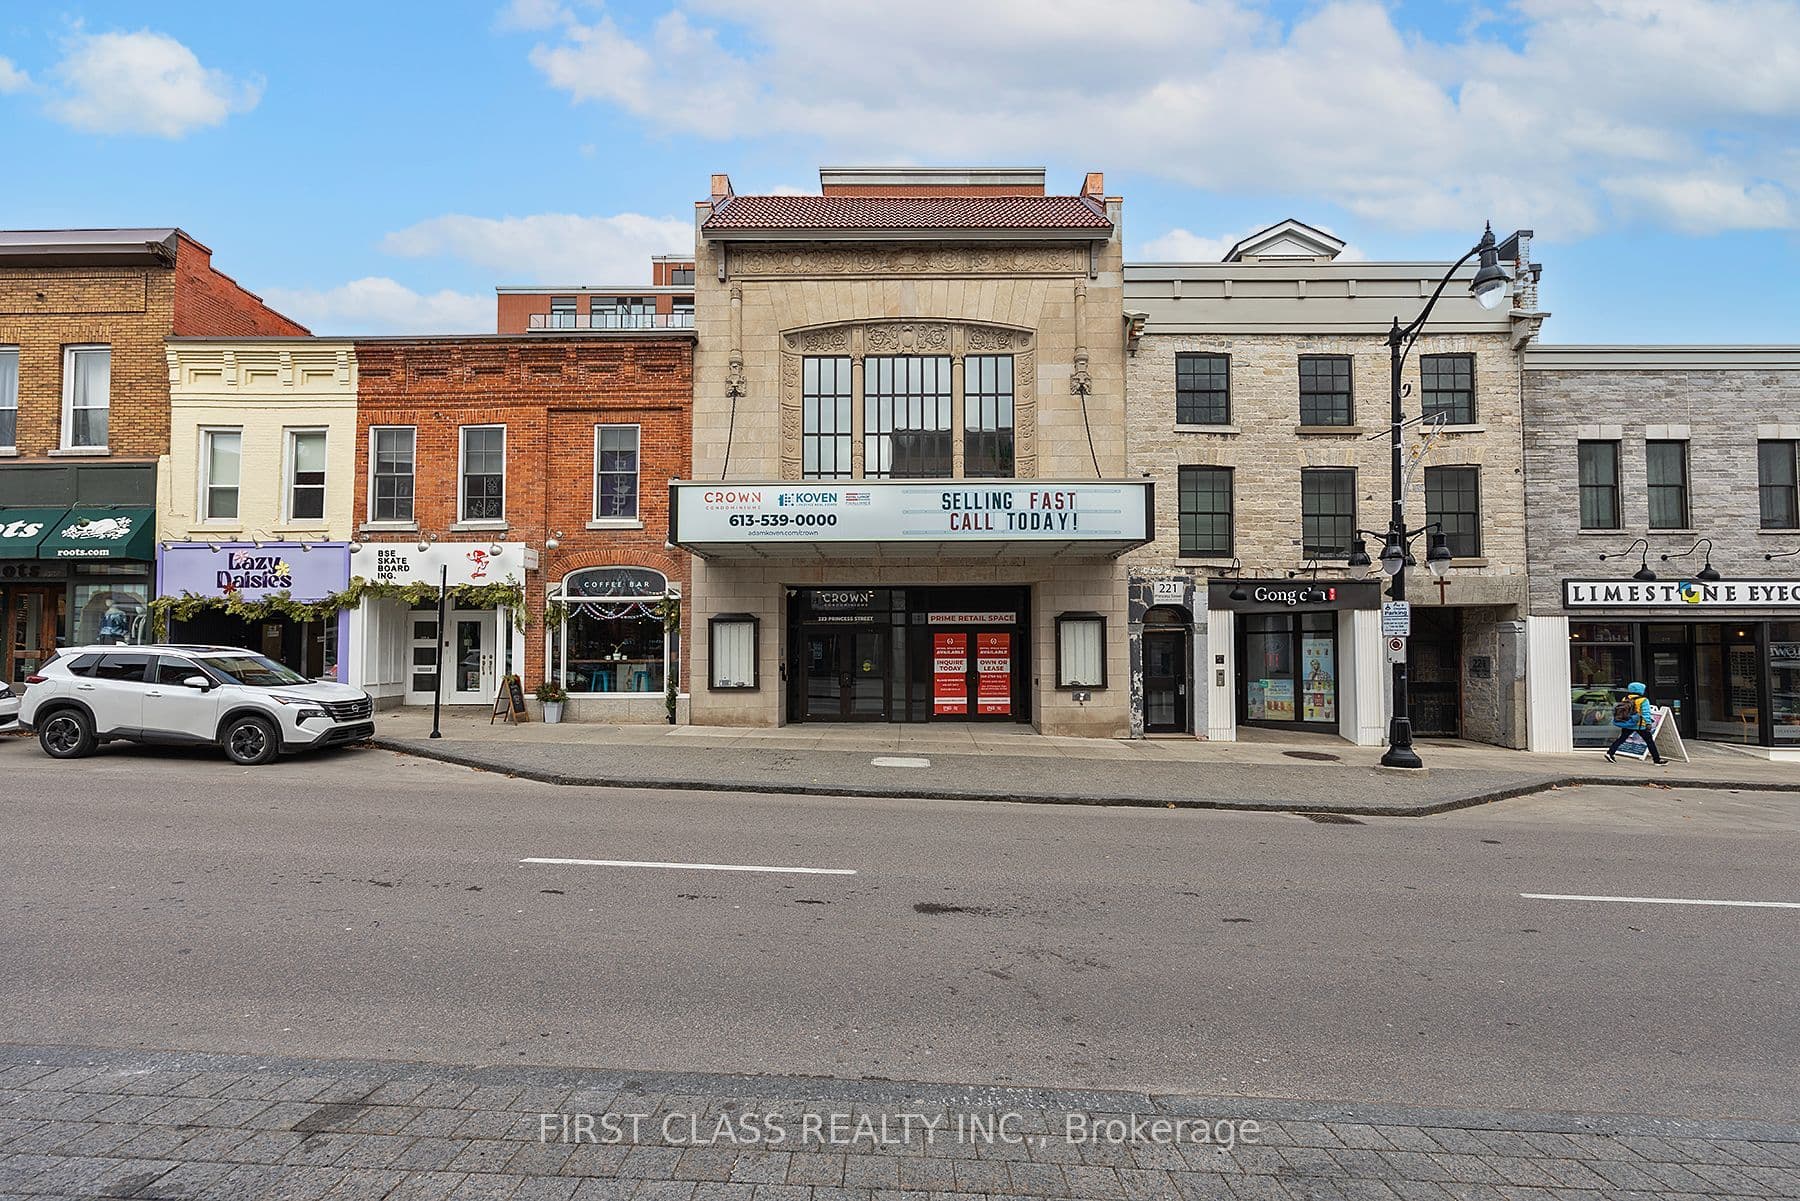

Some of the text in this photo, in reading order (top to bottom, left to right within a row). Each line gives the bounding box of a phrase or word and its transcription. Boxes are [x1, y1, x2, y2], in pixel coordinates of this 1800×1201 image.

[704, 492, 761, 503] CROWN
[796, 492, 837, 503] KOVEN
[942, 492, 1076, 510] SELLING FAST
[729, 514, 837, 527] 613-539-0000
[950, 512, 1077, 530] CALL TODAY!
[57, 548, 110, 556] roots.com
[229, 552, 282, 574] Lazy
[217, 571, 292, 590] Daisies
[378, 572, 397, 580] ING.
[1159, 584, 1177, 593] 221
[823, 593, 868, 603] CROWN
[1255, 587, 1297, 606] Gong
